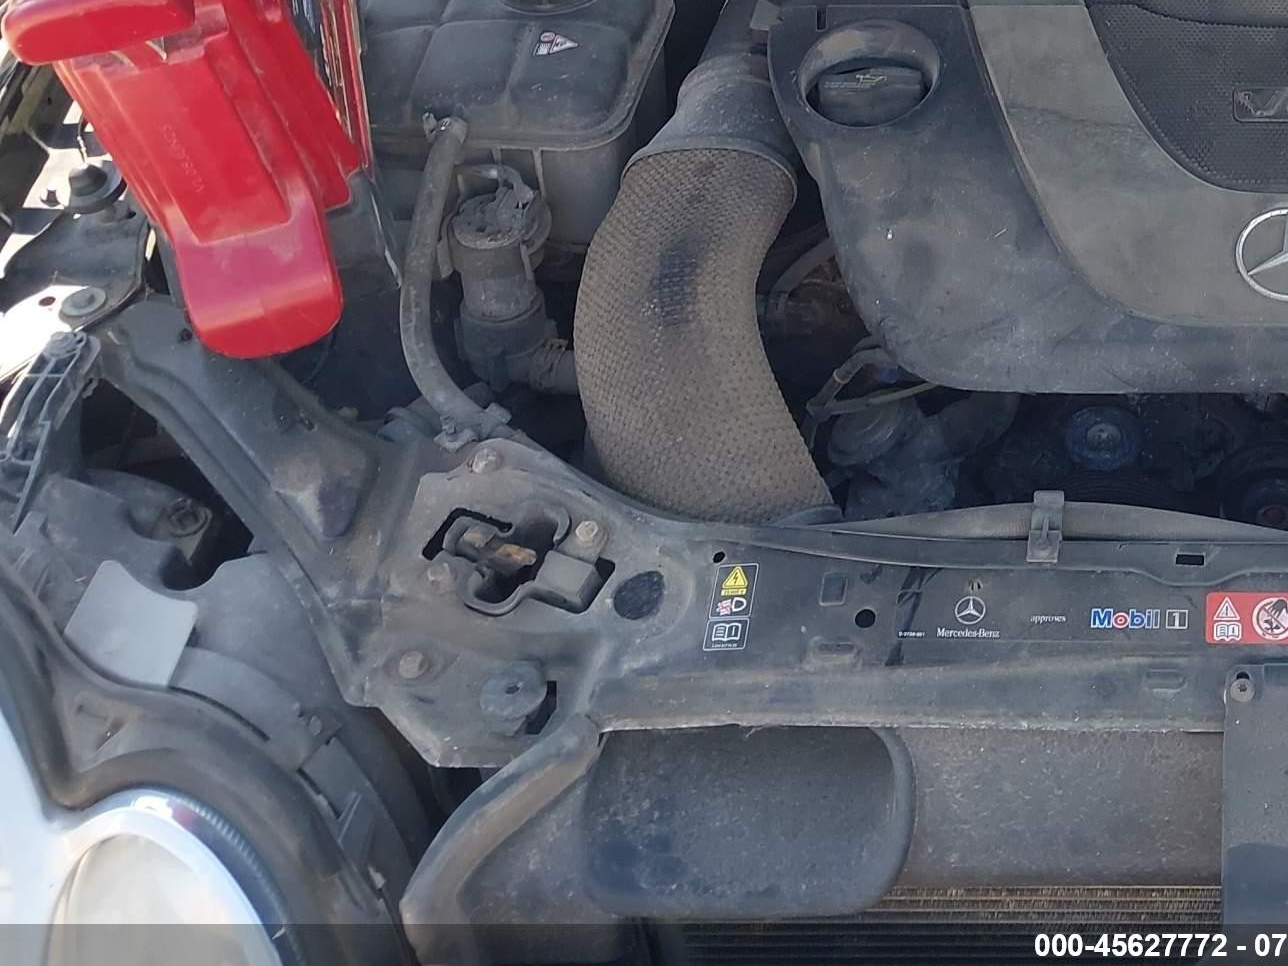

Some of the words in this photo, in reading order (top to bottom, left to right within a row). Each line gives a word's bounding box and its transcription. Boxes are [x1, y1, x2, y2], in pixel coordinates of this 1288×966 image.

[1030, 614, 1066, 624] approves
[1090, 608, 1161, 630] Mobil
[936, 627, 1000, 639] Mercedes-Benz
